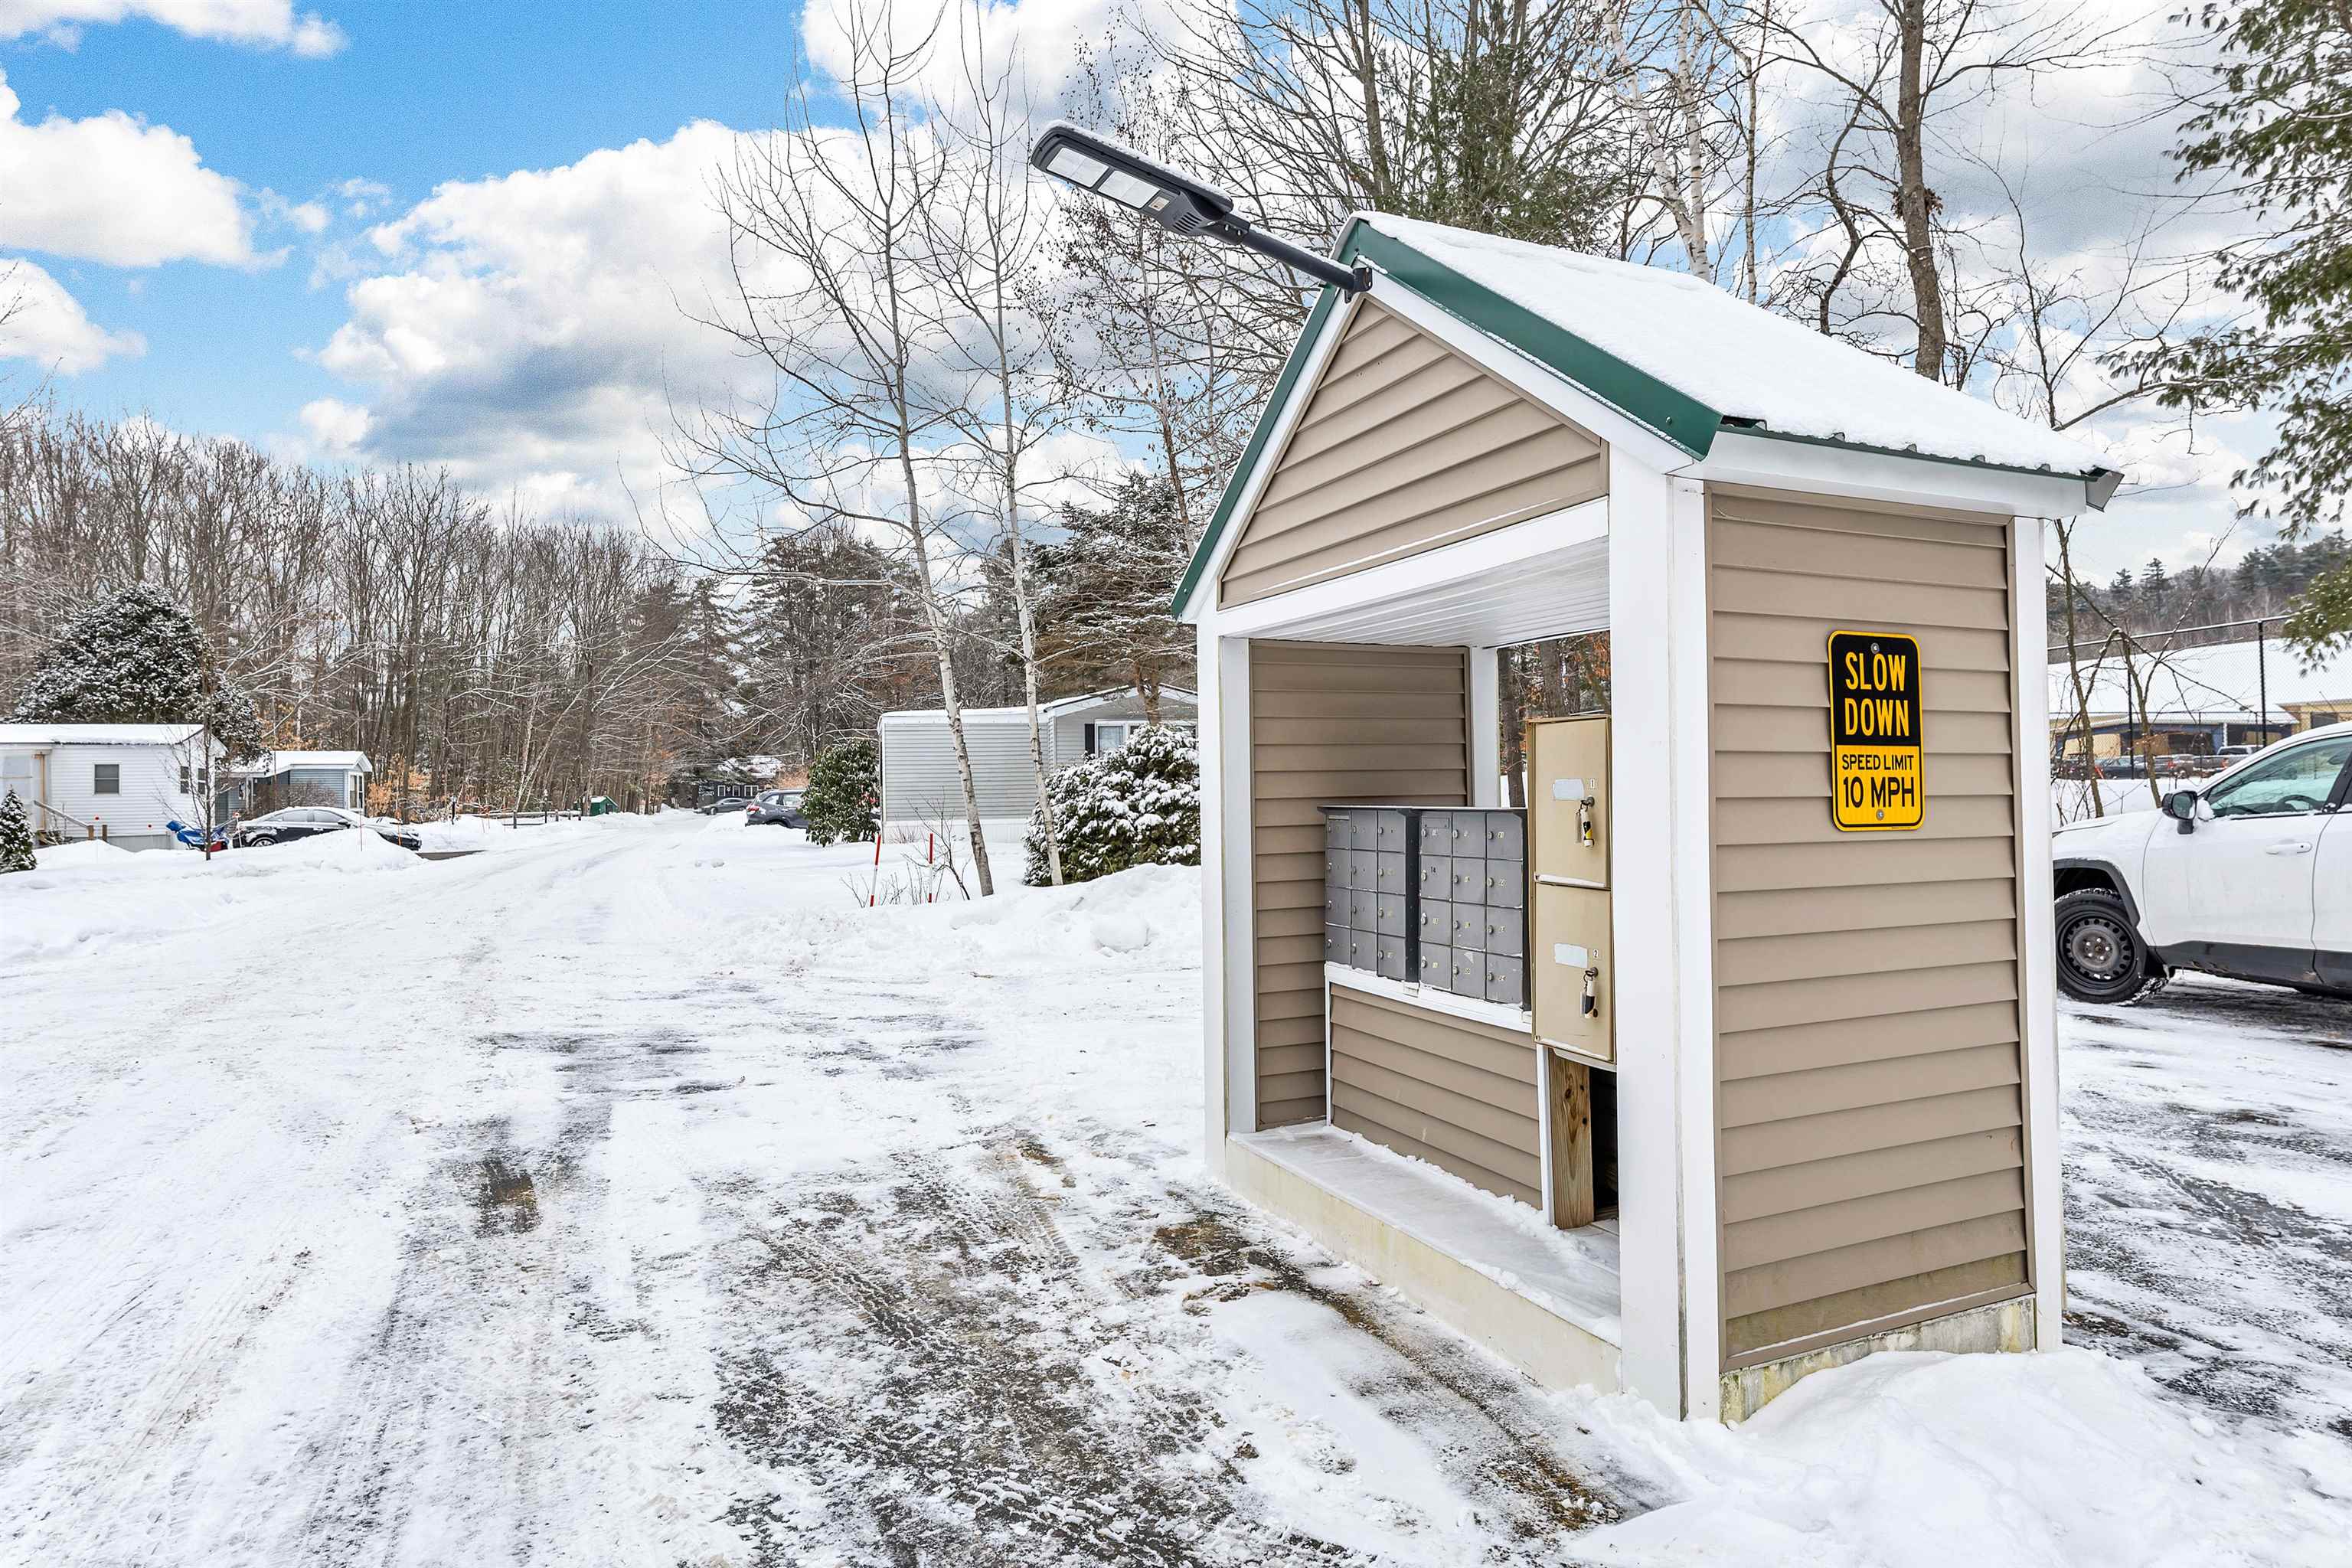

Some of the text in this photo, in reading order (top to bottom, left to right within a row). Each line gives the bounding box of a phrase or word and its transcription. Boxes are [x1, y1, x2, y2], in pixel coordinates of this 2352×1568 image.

[1845, 651, 1906, 691] SLOW
[1845, 697, 1909, 737] DOWN
[1841, 754, 1914, 771] SPEED LIMIT
[1843, 776, 1915, 808] 10 MPH
